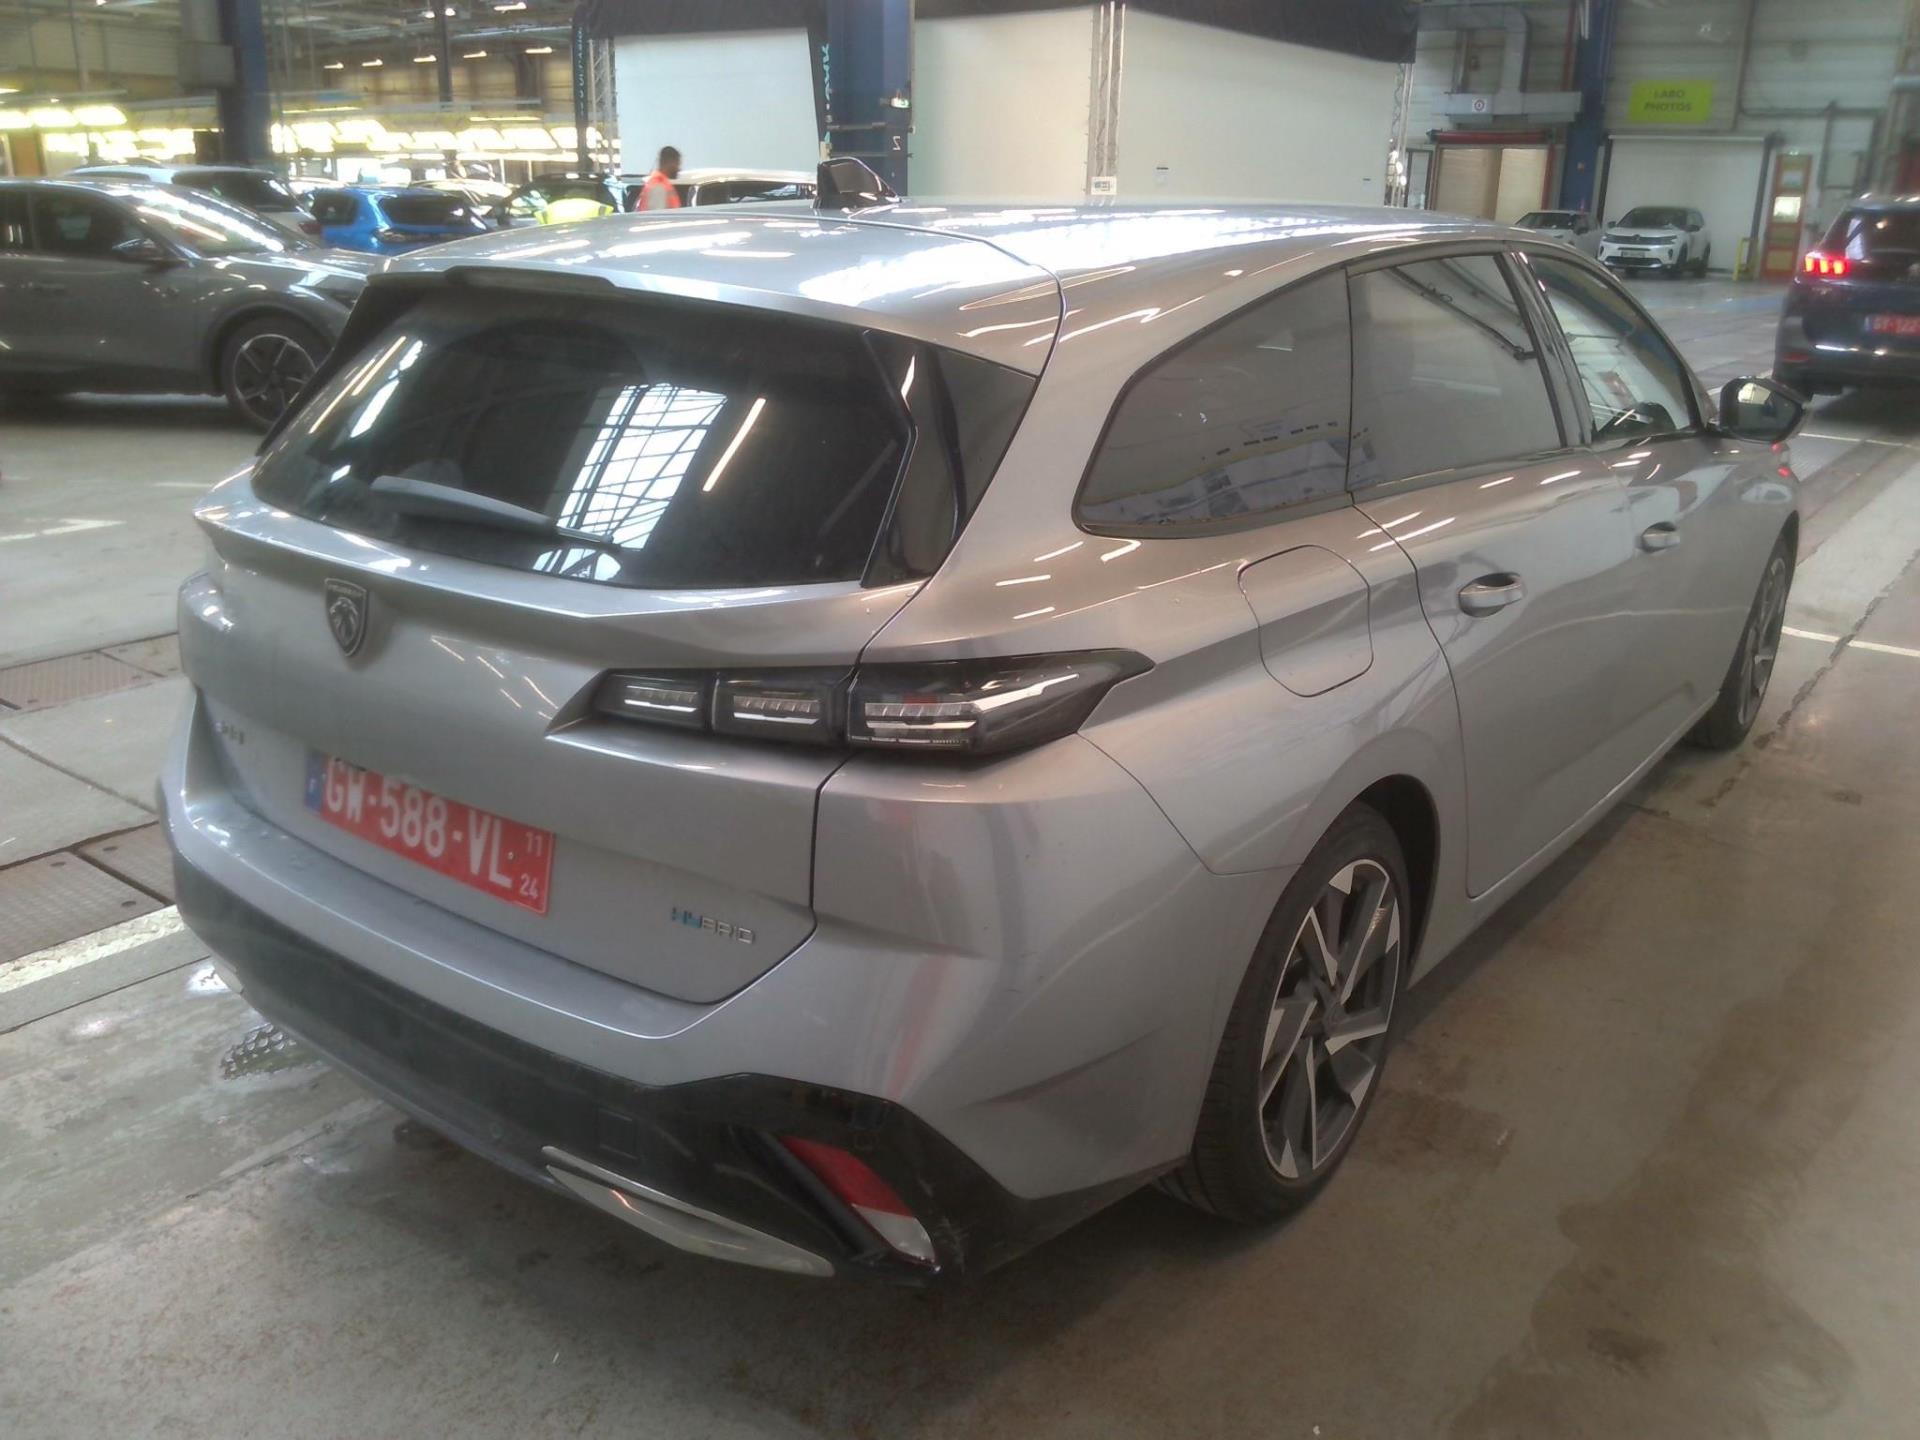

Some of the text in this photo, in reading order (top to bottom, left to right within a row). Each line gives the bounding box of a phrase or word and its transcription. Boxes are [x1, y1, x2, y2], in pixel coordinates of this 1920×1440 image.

[1653, 89, 1686, 99] LABO
[1643, 102, 1693, 113] PHOTOS
[326, 755, 514, 890] GW-588-VL
[525, 831, 543, 857] 11
[519, 873, 540, 900] 24
